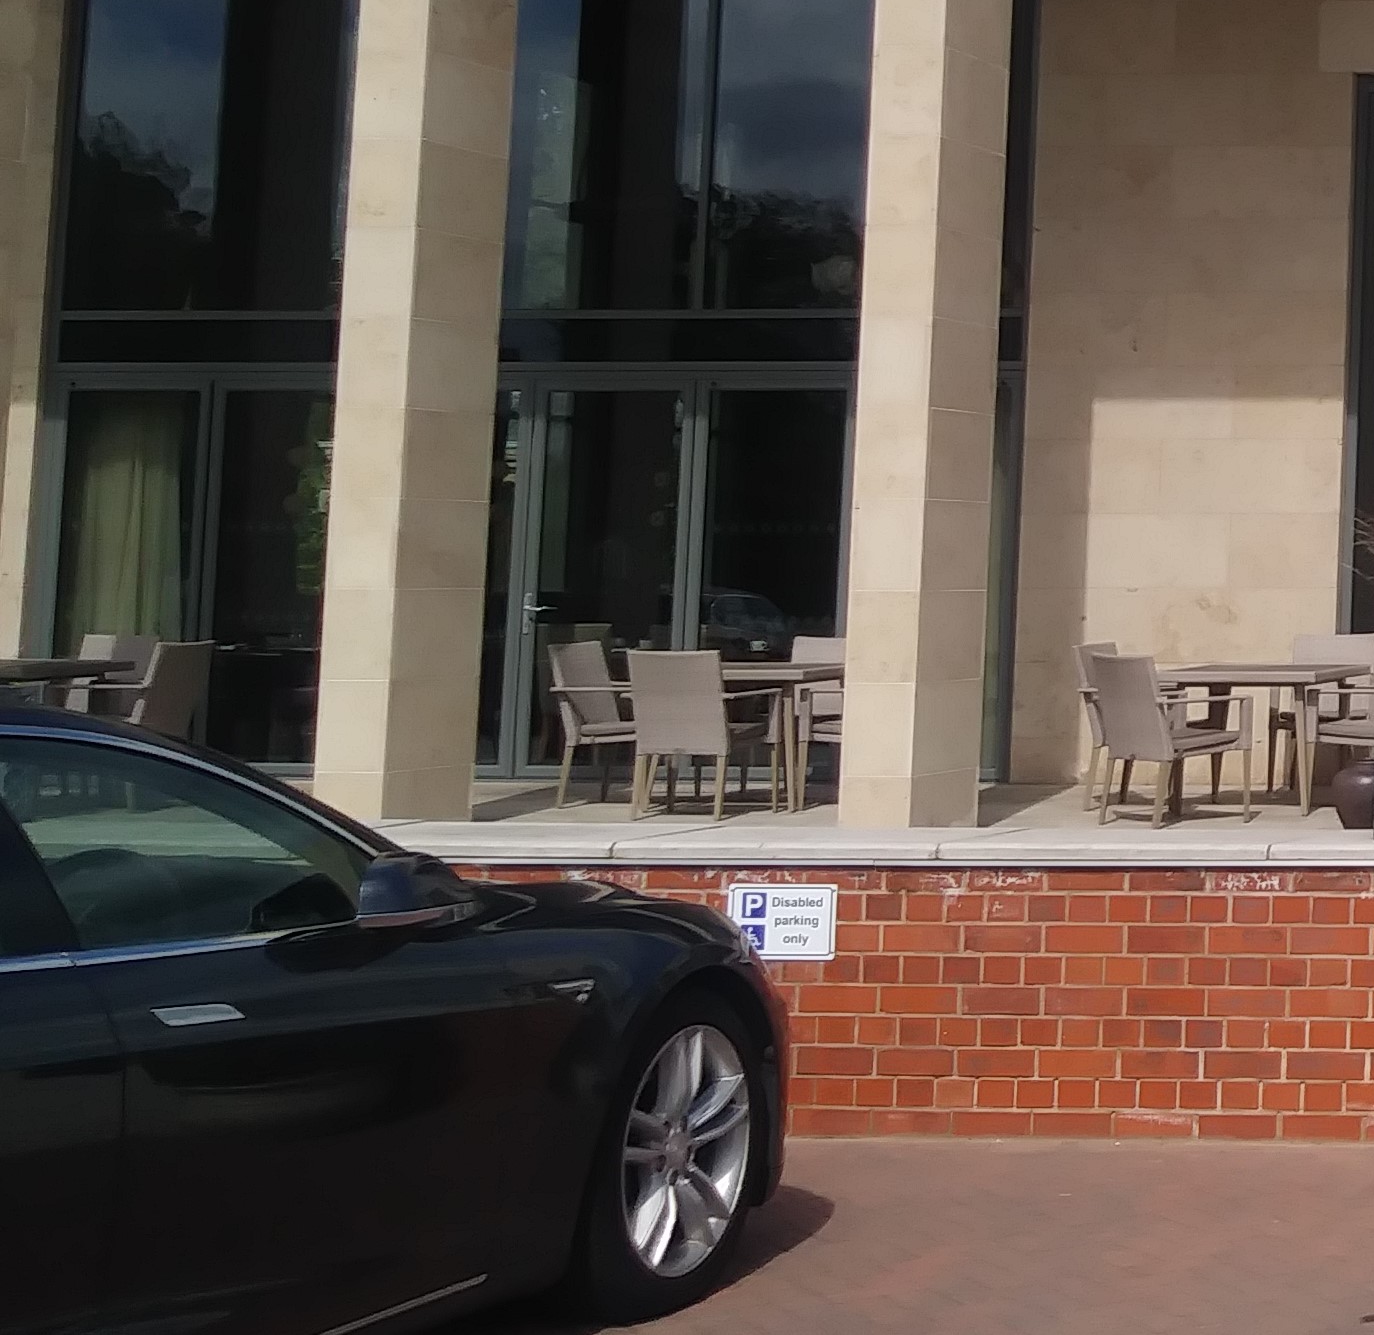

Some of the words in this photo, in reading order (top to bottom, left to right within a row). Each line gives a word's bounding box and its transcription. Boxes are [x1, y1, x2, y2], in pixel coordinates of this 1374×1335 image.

[745, 894, 763, 917] P
[772, 897, 823, 907] Disabled
[774, 915, 819, 928] parking
[783, 934, 809, 946] only
